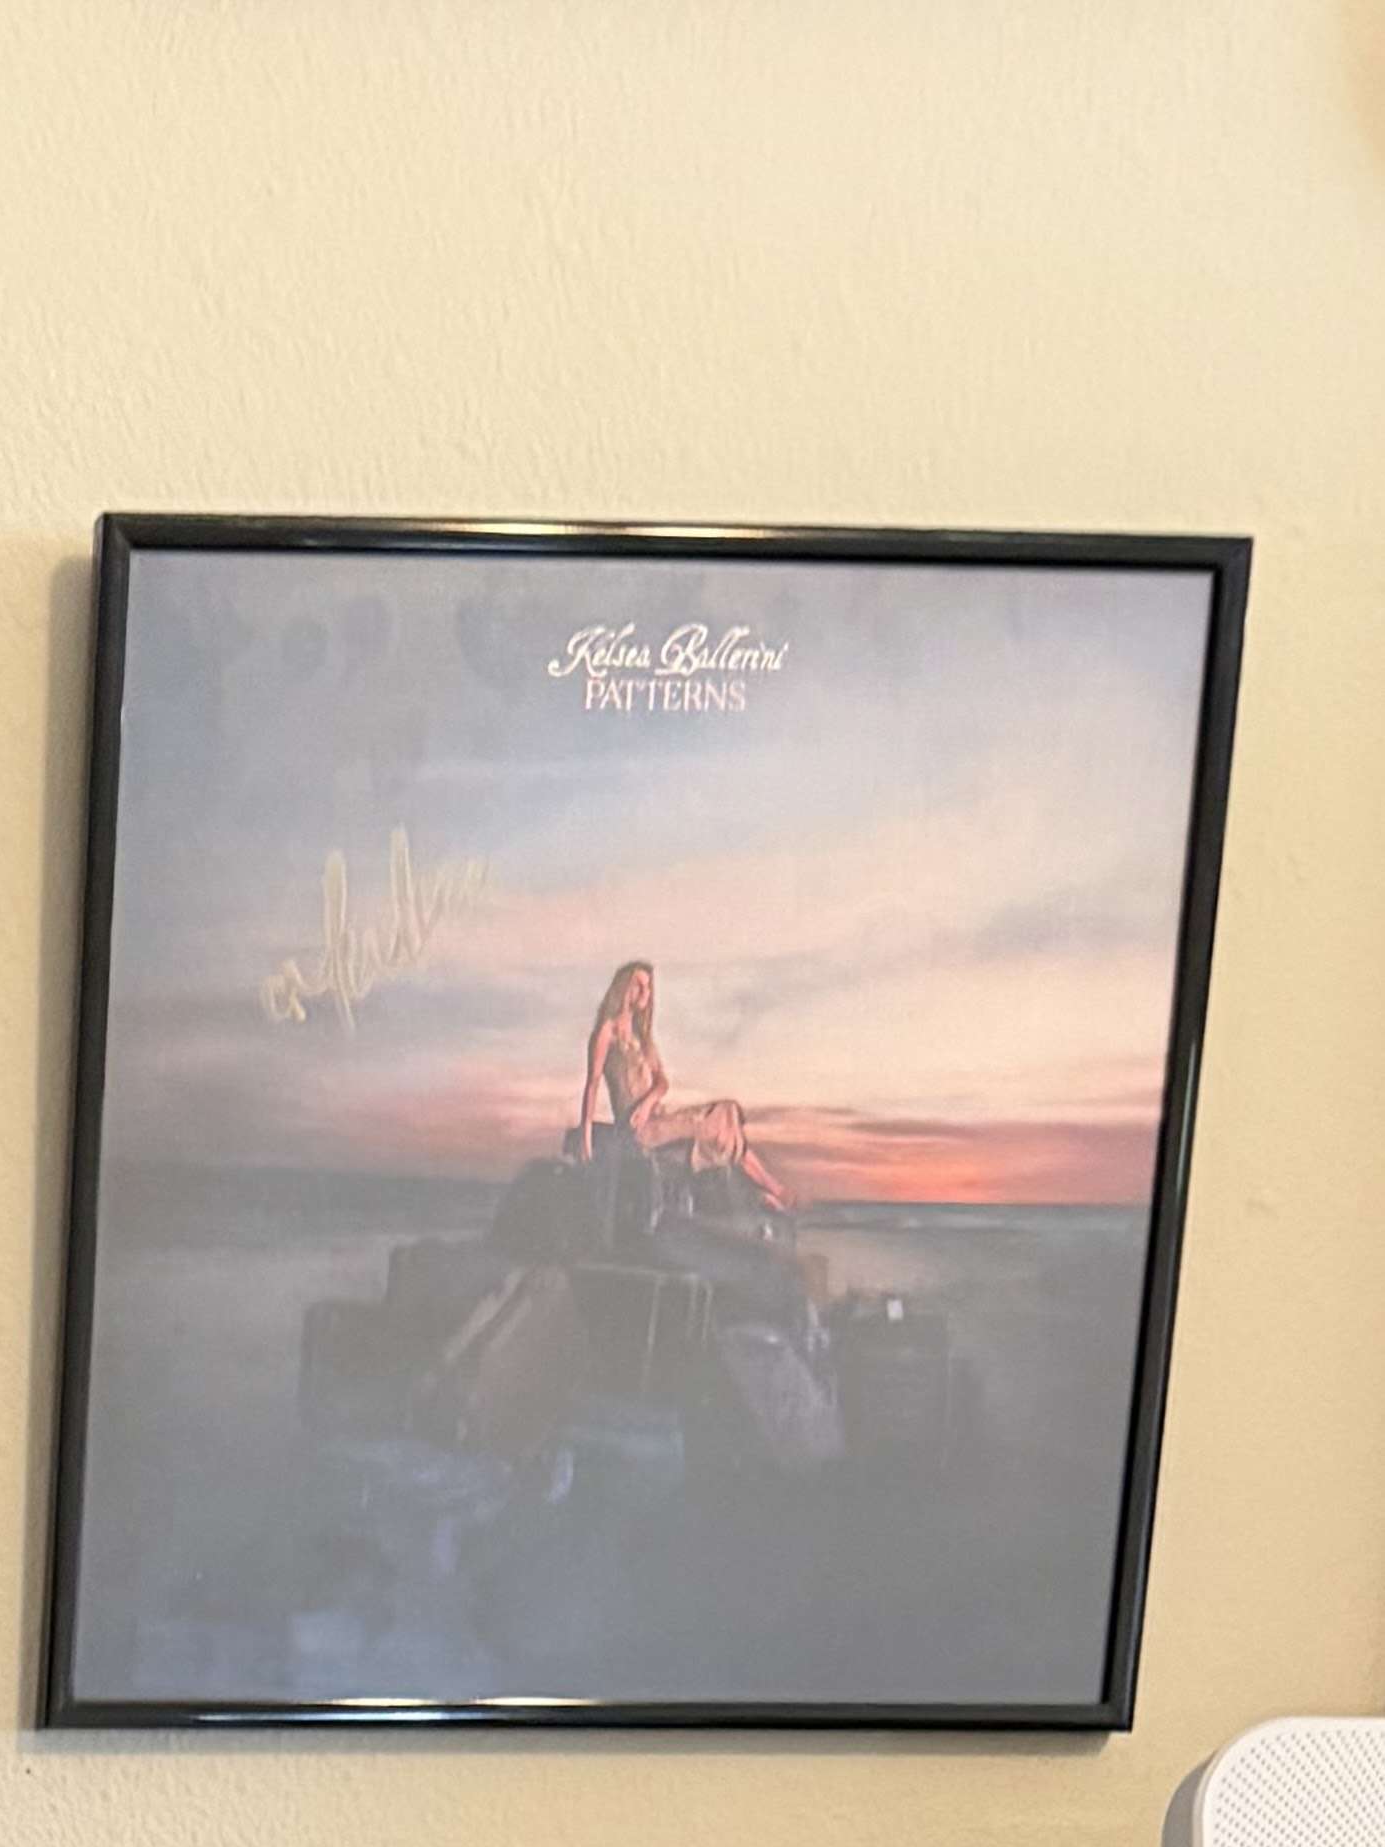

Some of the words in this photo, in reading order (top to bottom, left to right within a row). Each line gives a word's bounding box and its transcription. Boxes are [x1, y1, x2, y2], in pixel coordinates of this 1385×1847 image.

[548, 623, 650, 676] Kelsea
[654, 623, 789, 676] Ballerini
[584, 679, 746, 711] PATTERNS
